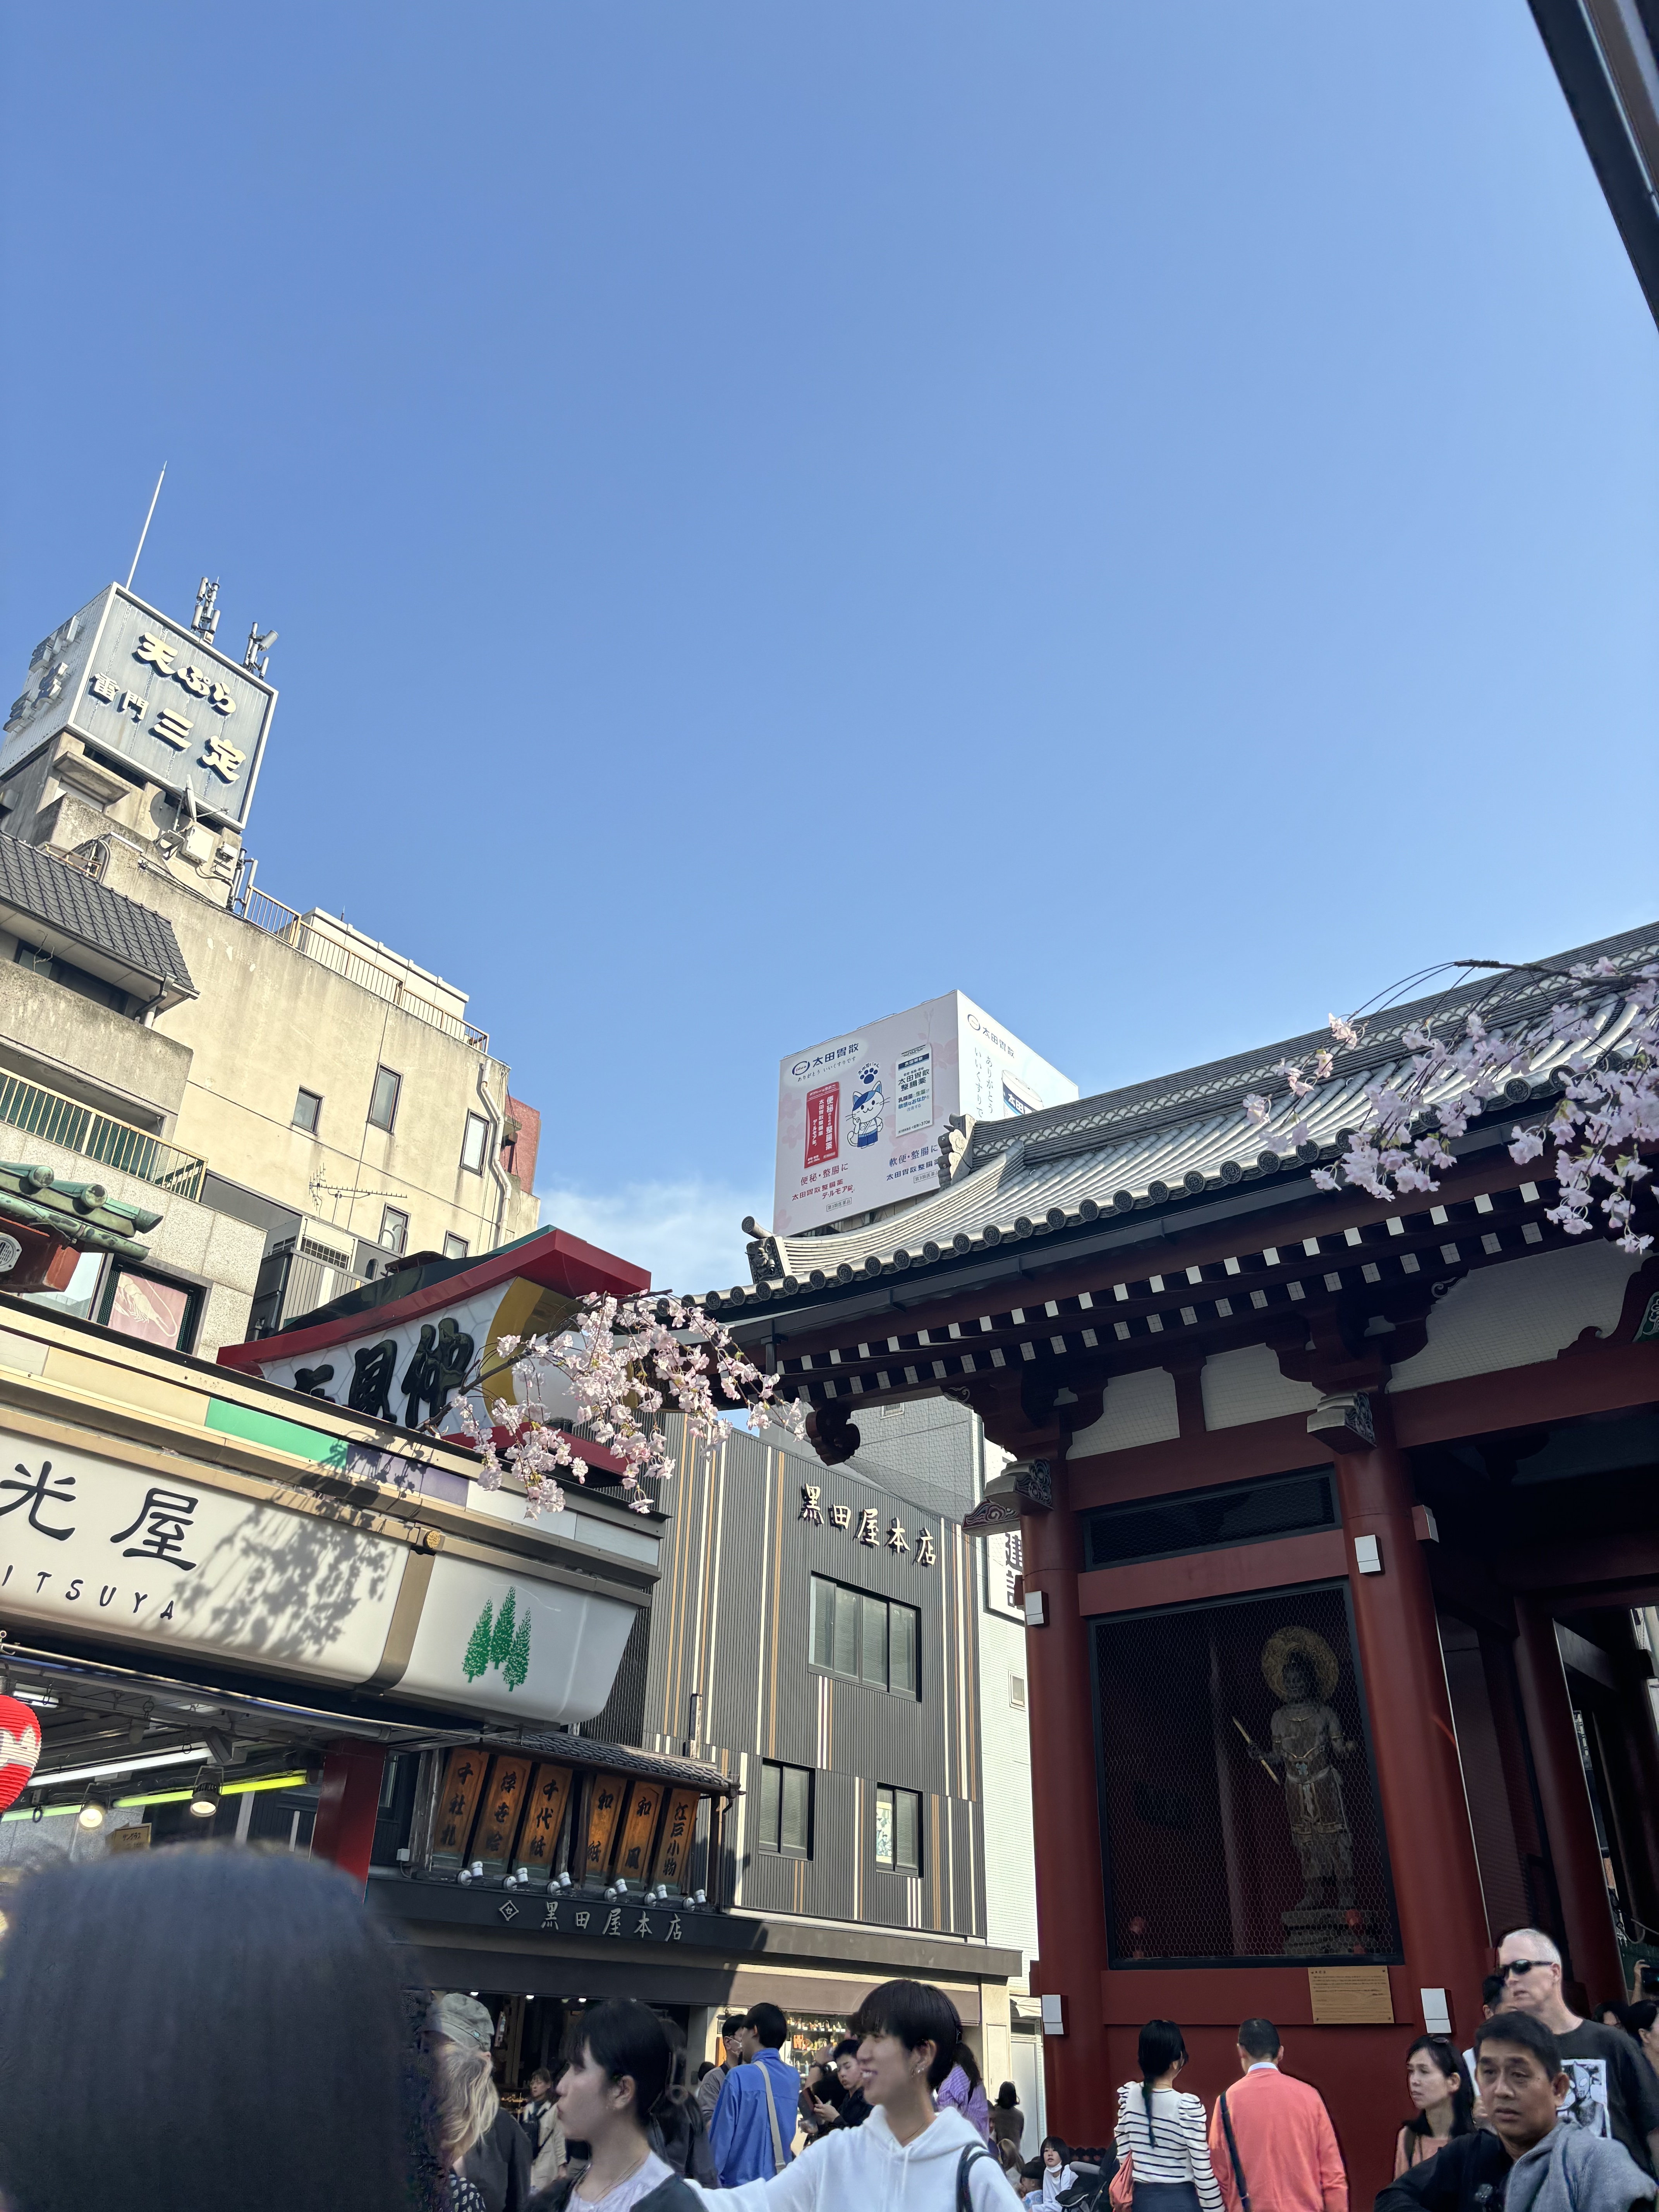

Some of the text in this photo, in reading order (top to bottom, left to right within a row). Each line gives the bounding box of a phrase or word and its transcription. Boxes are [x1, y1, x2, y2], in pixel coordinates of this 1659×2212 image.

[137, 632, 236, 714] 天ぷら
[92, 672, 246, 781] 雷門 三定
[798, 1070, 820, 1082] ありがとう
[823, 1056, 856, 1072] いいくすりです
[812, 1043, 859, 1068] 太田胃散
[801, 1163, 848, 1186] 便秘・整腸に
[889, 1145, 938, 1167] 軟便・整腸に
[0, 1461, 199, 1571] 光屋
[804, 1483, 936, 1565] 黒田屋本店
[2, 1565, 174, 1620] ITSUYA
[440, 1762, 473, 1846] 千社札
[530, 1779, 559, 1857] 千代紙
[587, 1789, 613, 1863] 和紙
[663, 1802, 688, 1876] 江戸小物
[541, 1901, 682, 1942] 黒田屋本店
